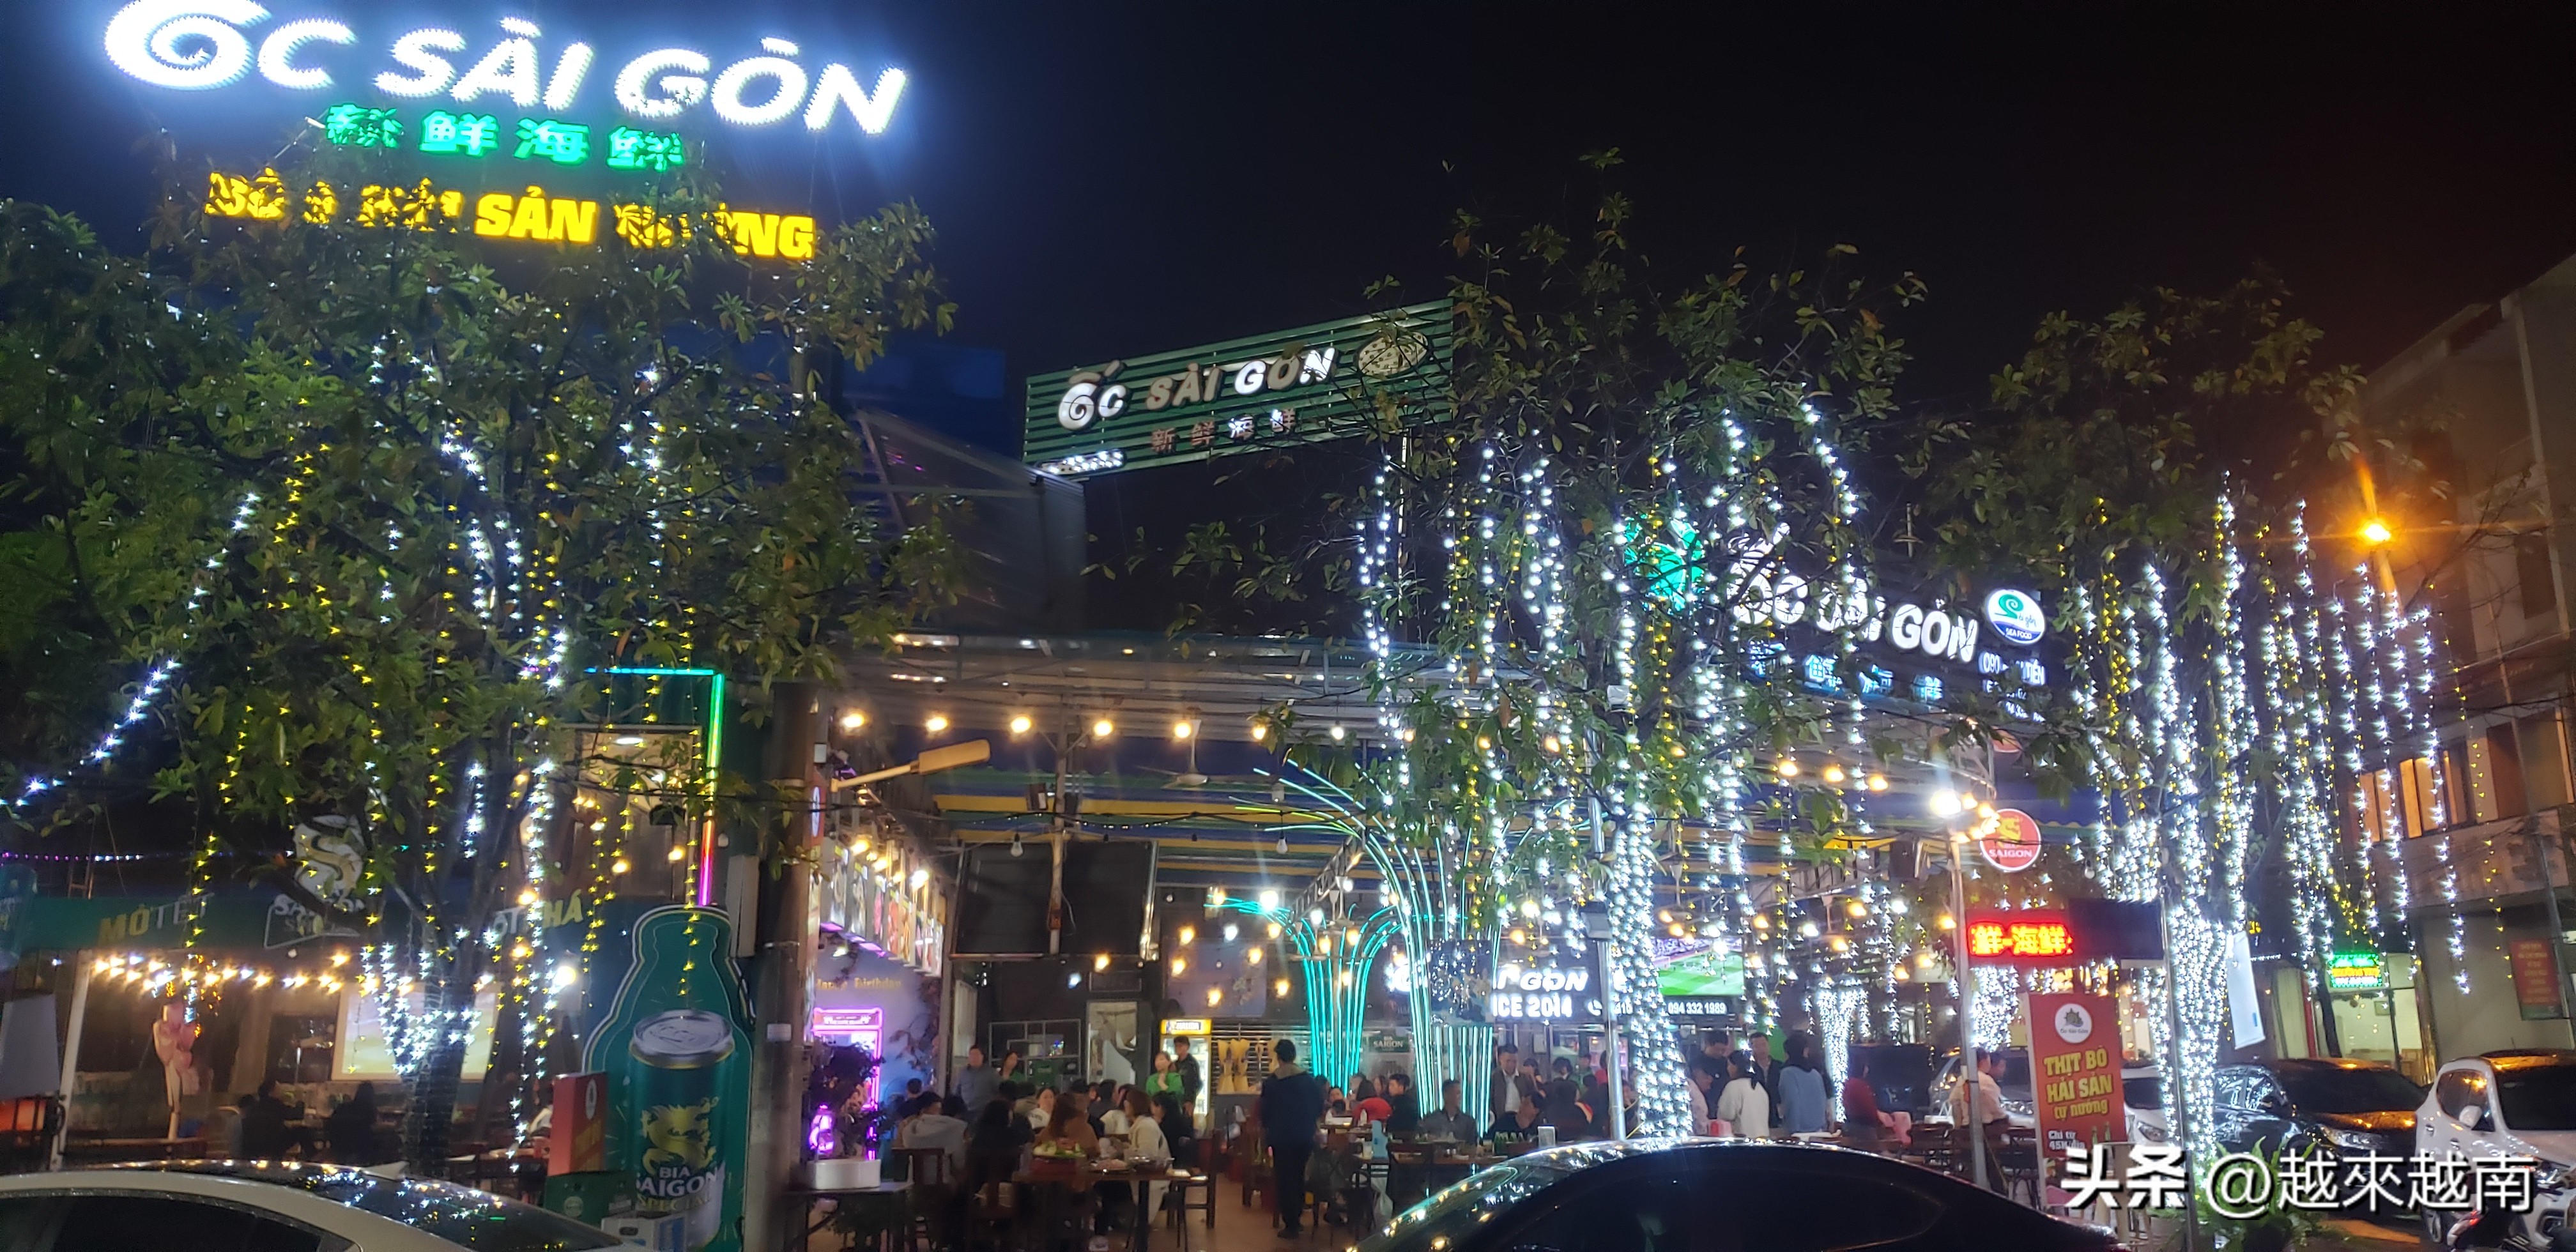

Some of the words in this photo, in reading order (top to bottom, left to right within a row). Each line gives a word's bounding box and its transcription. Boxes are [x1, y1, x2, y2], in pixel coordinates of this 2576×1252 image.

[373, 16, 594, 111] SÀI
[615, 36, 907, 136] GÒN
[475, 185, 598, 244] SẢN
[1146, 362, 1222, 410] SÀI
[1988, 849, 2032, 858] SAIGON
[1528, 992, 1572, 1018] 2014
[1668, 1002, 1685, 1014] 094
[1687, 1002, 1703, 1014] 332
[2044, 1051, 2082, 1076] THỊT
[2079, 1071, 2113, 1098] SẢN
[659, 1166, 690, 1178] BIA
